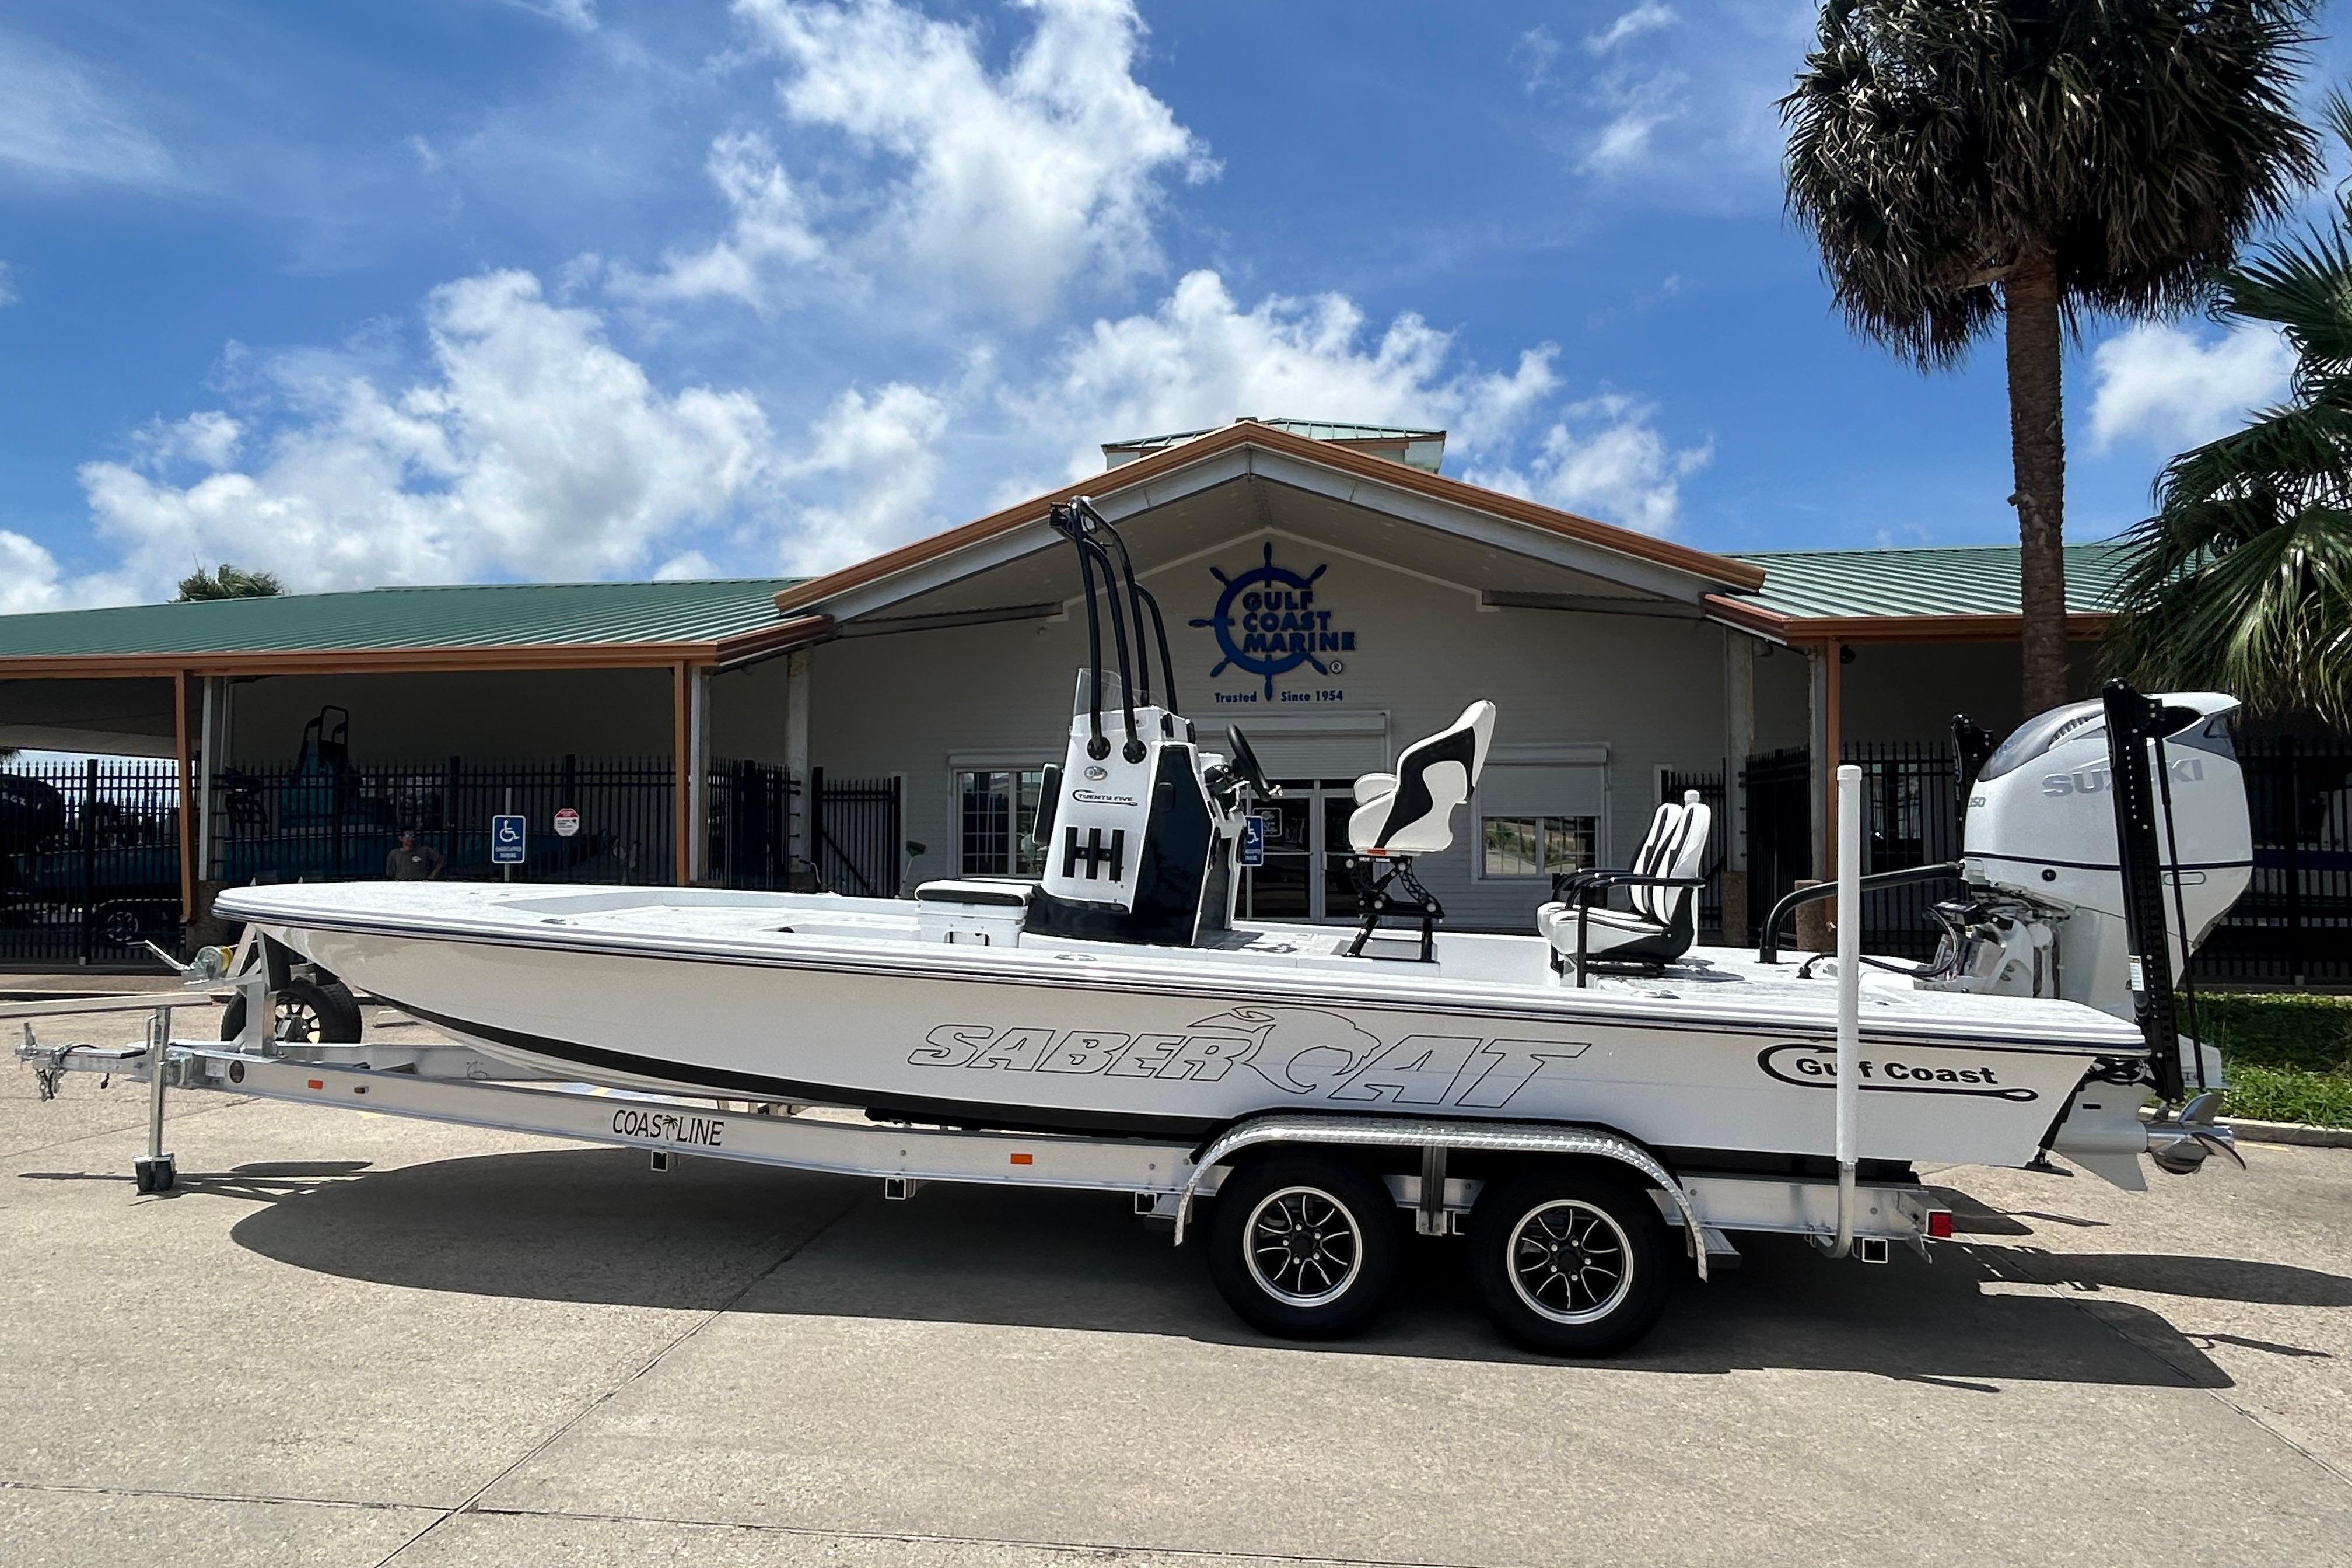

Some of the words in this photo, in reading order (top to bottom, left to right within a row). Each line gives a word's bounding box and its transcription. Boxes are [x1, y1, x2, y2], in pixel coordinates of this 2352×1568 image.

[1242, 590, 1313, 611] GULF
[1242, 611, 1331, 632] COAST
[1242, 632, 1355, 653] MARINE
[1214, 691, 1257, 703] Trusted
[1280, 691, 1311, 702] Since
[1315, 690, 1343, 701] 1954
[1796, 1058, 1874, 1078] Guf
[1884, 1062, 1999, 1085] Coast
